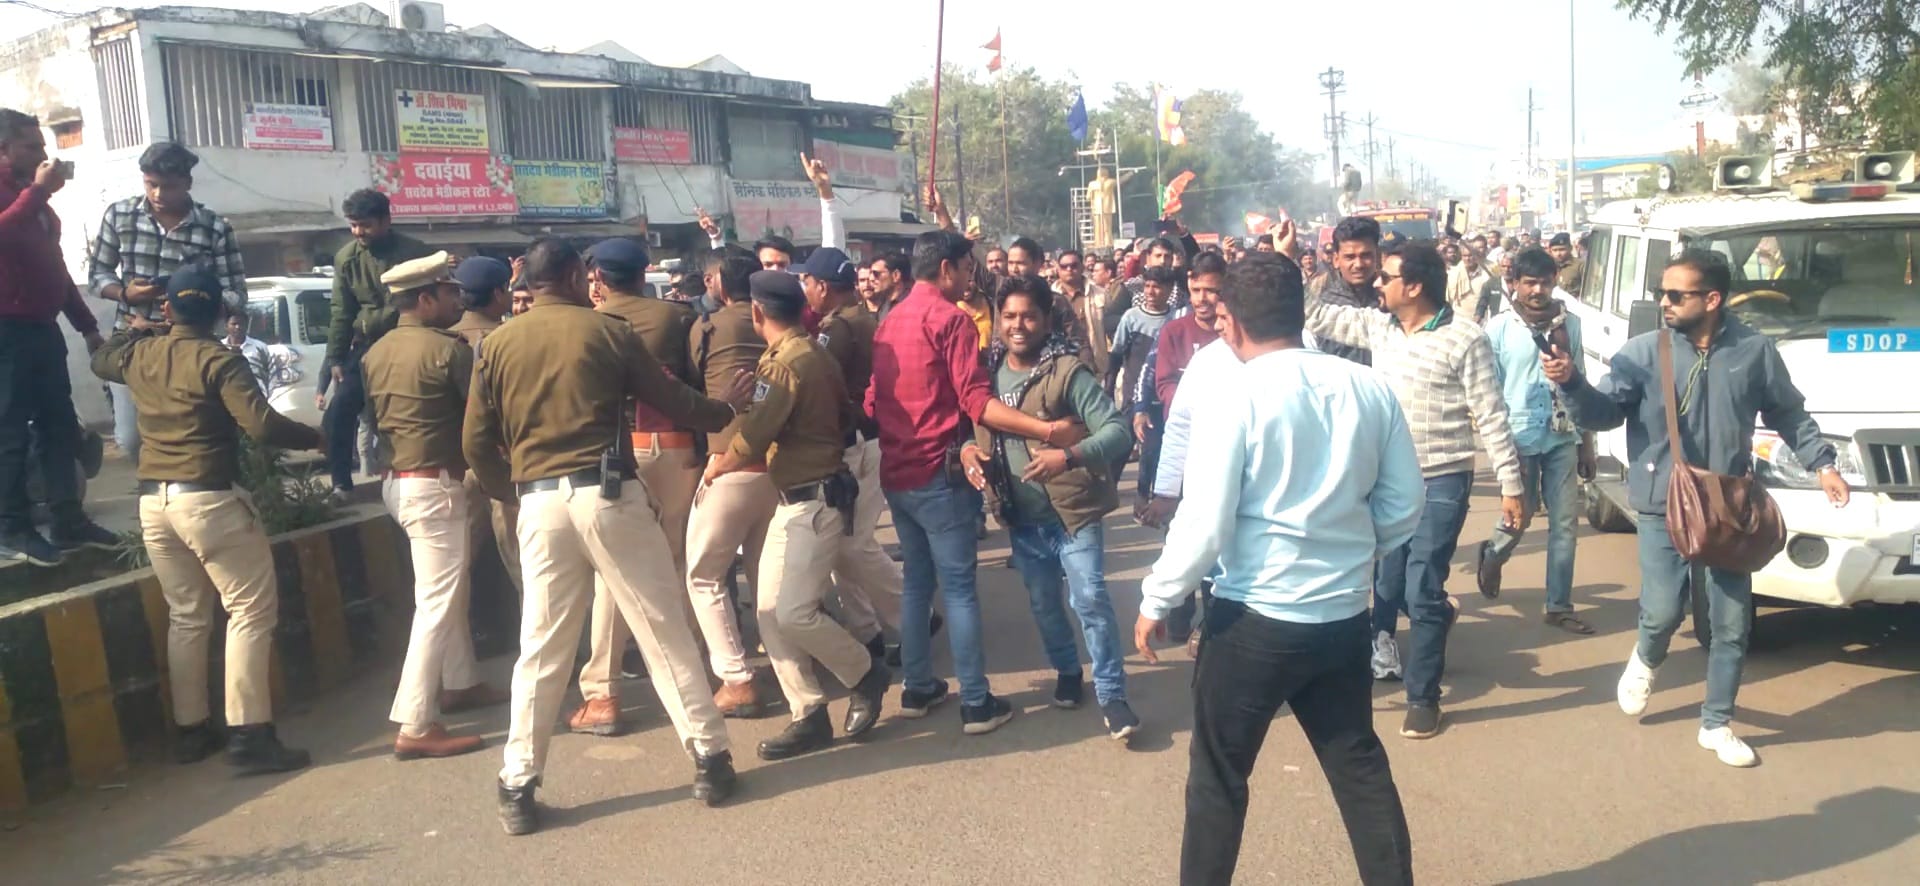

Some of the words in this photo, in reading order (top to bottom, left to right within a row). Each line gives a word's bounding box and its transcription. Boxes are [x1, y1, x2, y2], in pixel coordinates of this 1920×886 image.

[413, 157, 472, 182] दवाईया
[733, 181, 766, 198] सैनिक
[1846, 333, 1908, 351] SDOP
